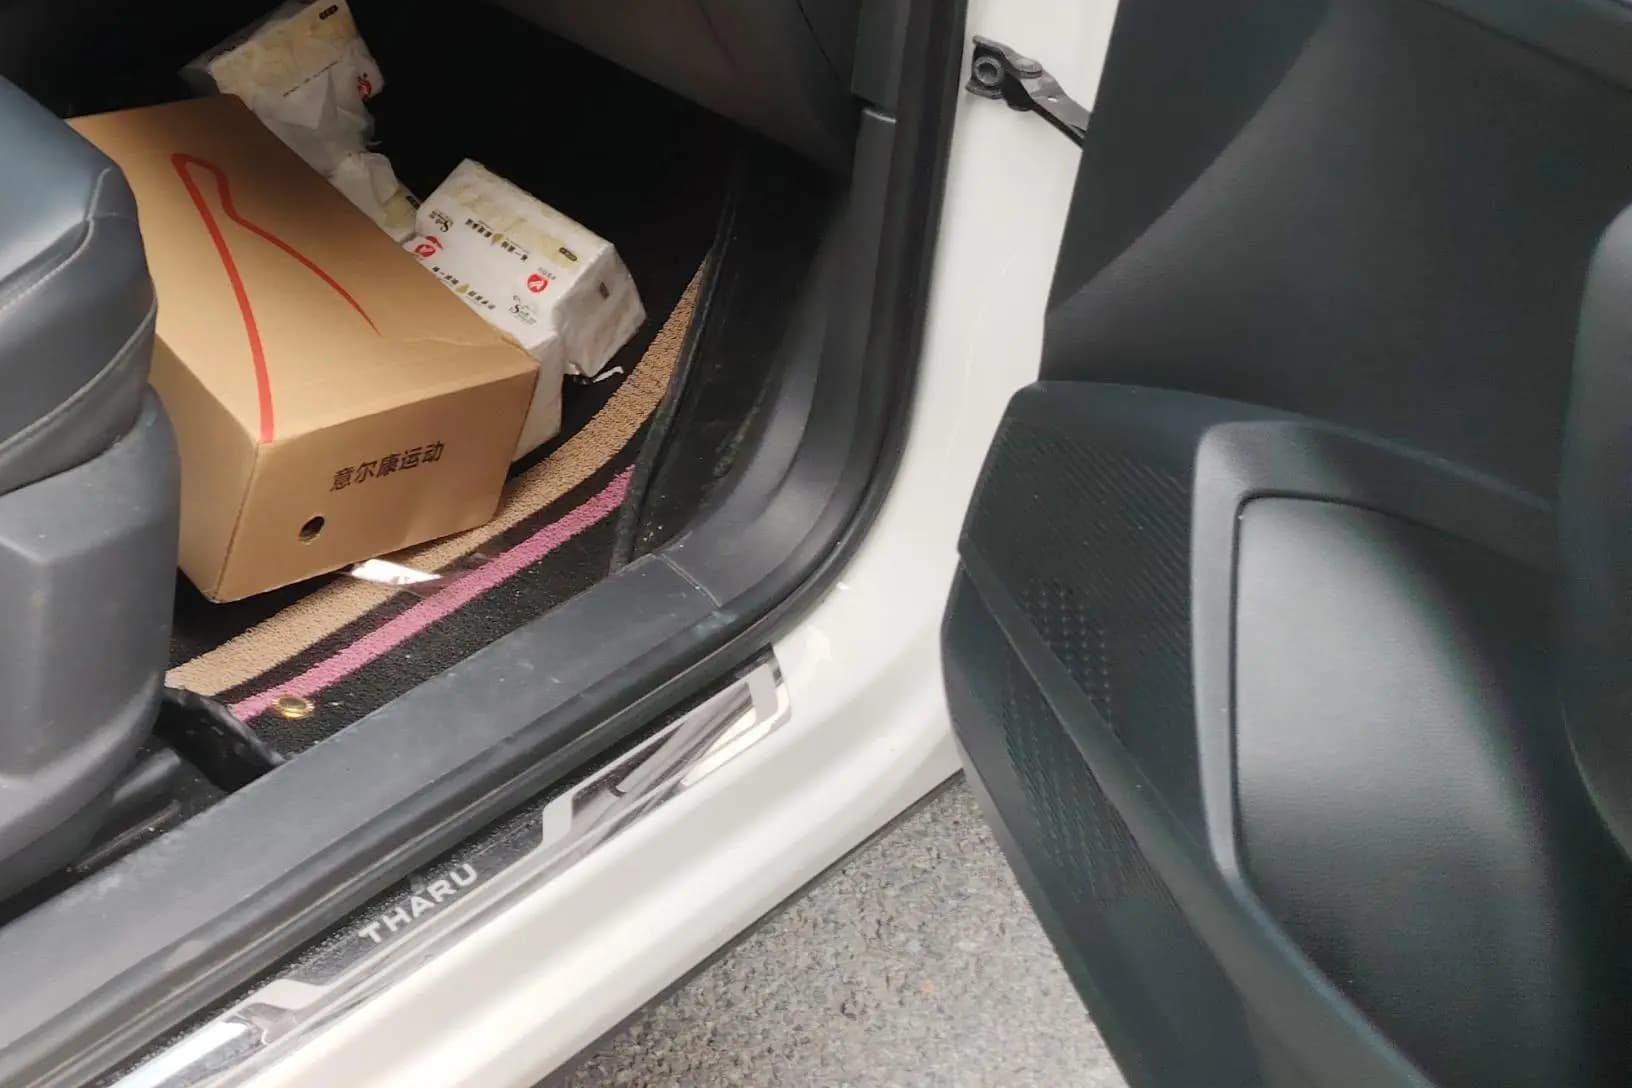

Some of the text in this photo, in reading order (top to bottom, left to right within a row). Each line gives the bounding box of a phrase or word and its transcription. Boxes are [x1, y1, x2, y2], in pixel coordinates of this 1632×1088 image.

[329, 440, 445, 492] 意尔康运动
[358, 862, 478, 944] THARU
